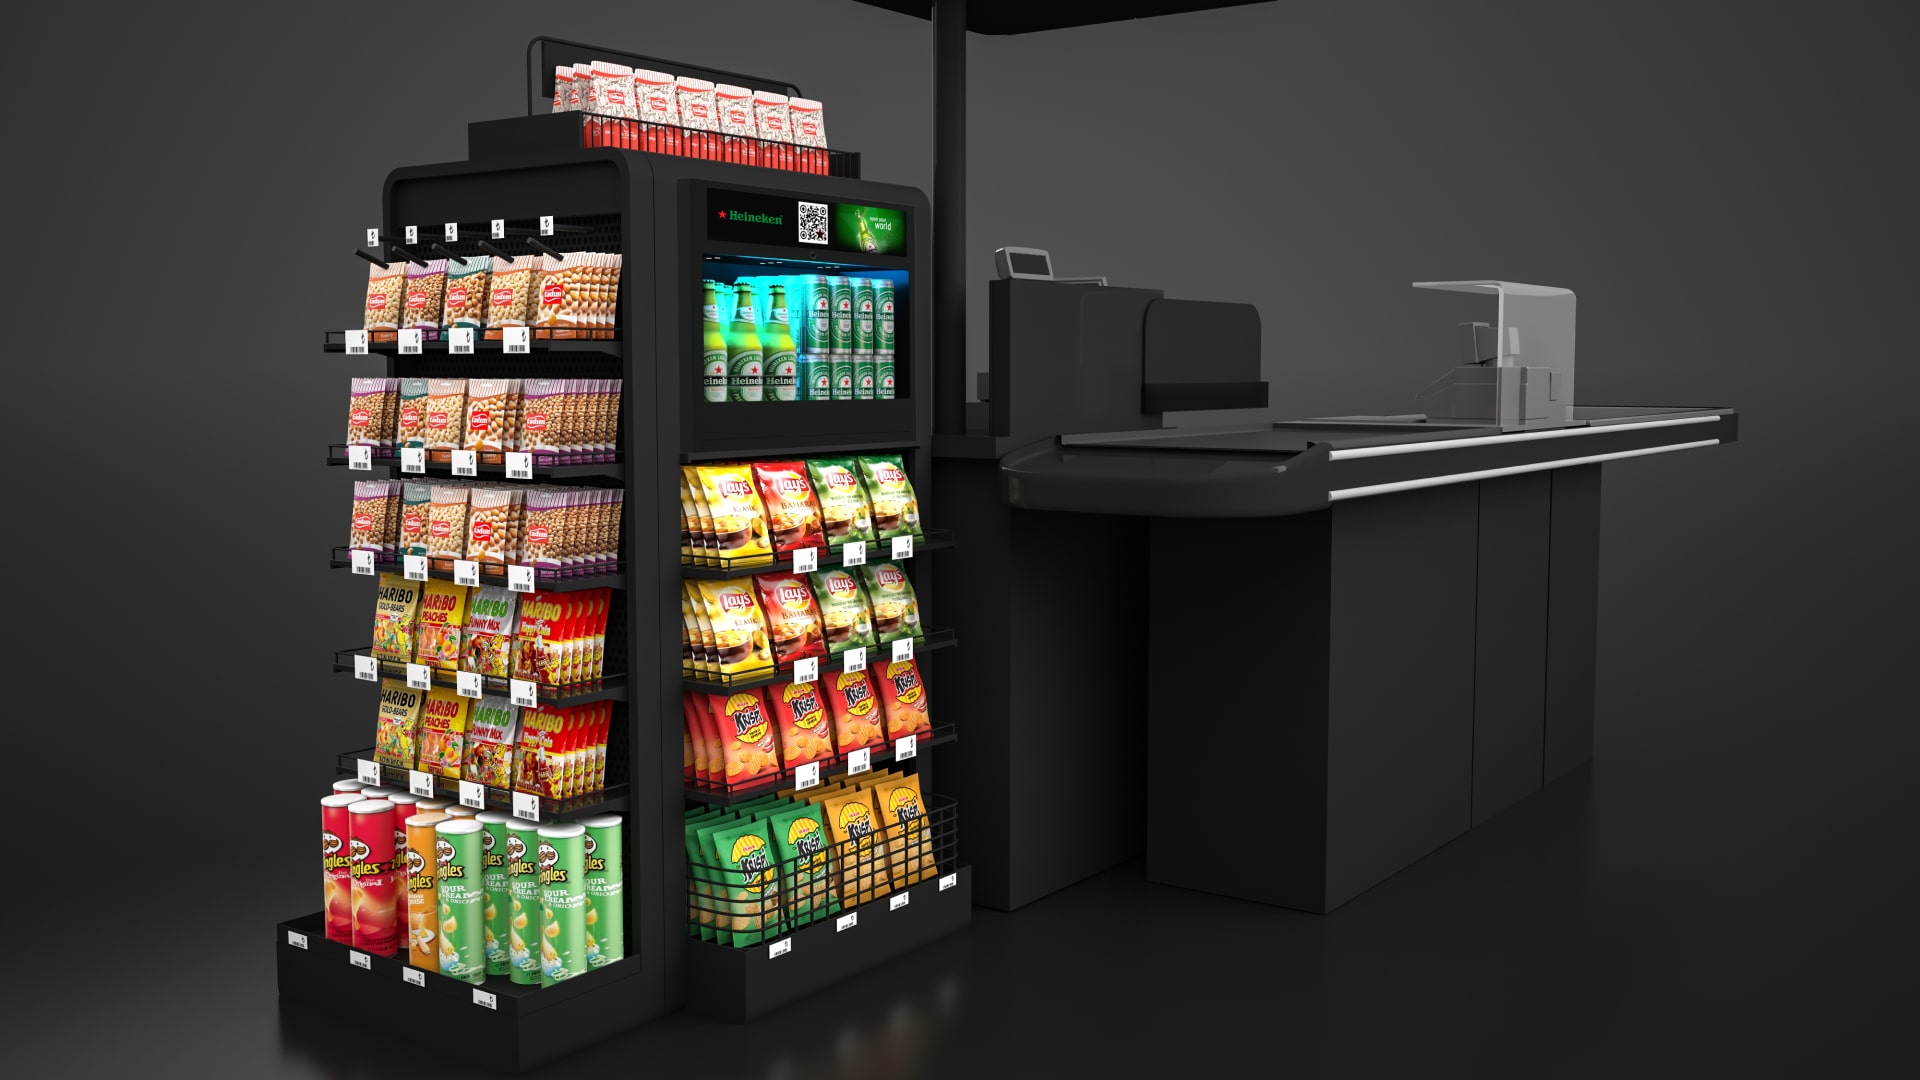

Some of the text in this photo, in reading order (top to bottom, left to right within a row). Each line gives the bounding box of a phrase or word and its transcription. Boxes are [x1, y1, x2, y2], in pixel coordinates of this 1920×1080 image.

[729, 210, 783, 225] Heineken
[874, 222, 891, 231] world
[829, 578, 854, 594] Lay's
[879, 569, 902, 586] Lay's
[379, 586, 413, 604] HARIBO
[424, 593, 456, 611] HARIBO
[723, 594, 751, 612] Lay's
[779, 587, 807, 604] Lay's
[422, 611, 448, 622] PEACHES
[521, 600, 561, 622] HARIBO
[382, 689, 416, 708] HARIBO
[426, 700, 459, 718] HARIBO
[425, 716, 450, 729] PEACHES
[523, 710, 564, 734] HARIBO
[324, 855, 351, 871] ngles
[483, 852, 503, 869] gles
[508, 858, 534, 877] ngles
[351, 863, 380, 878] ngles
[437, 865, 463, 881] ngles
[408, 874, 433, 892] ngles
